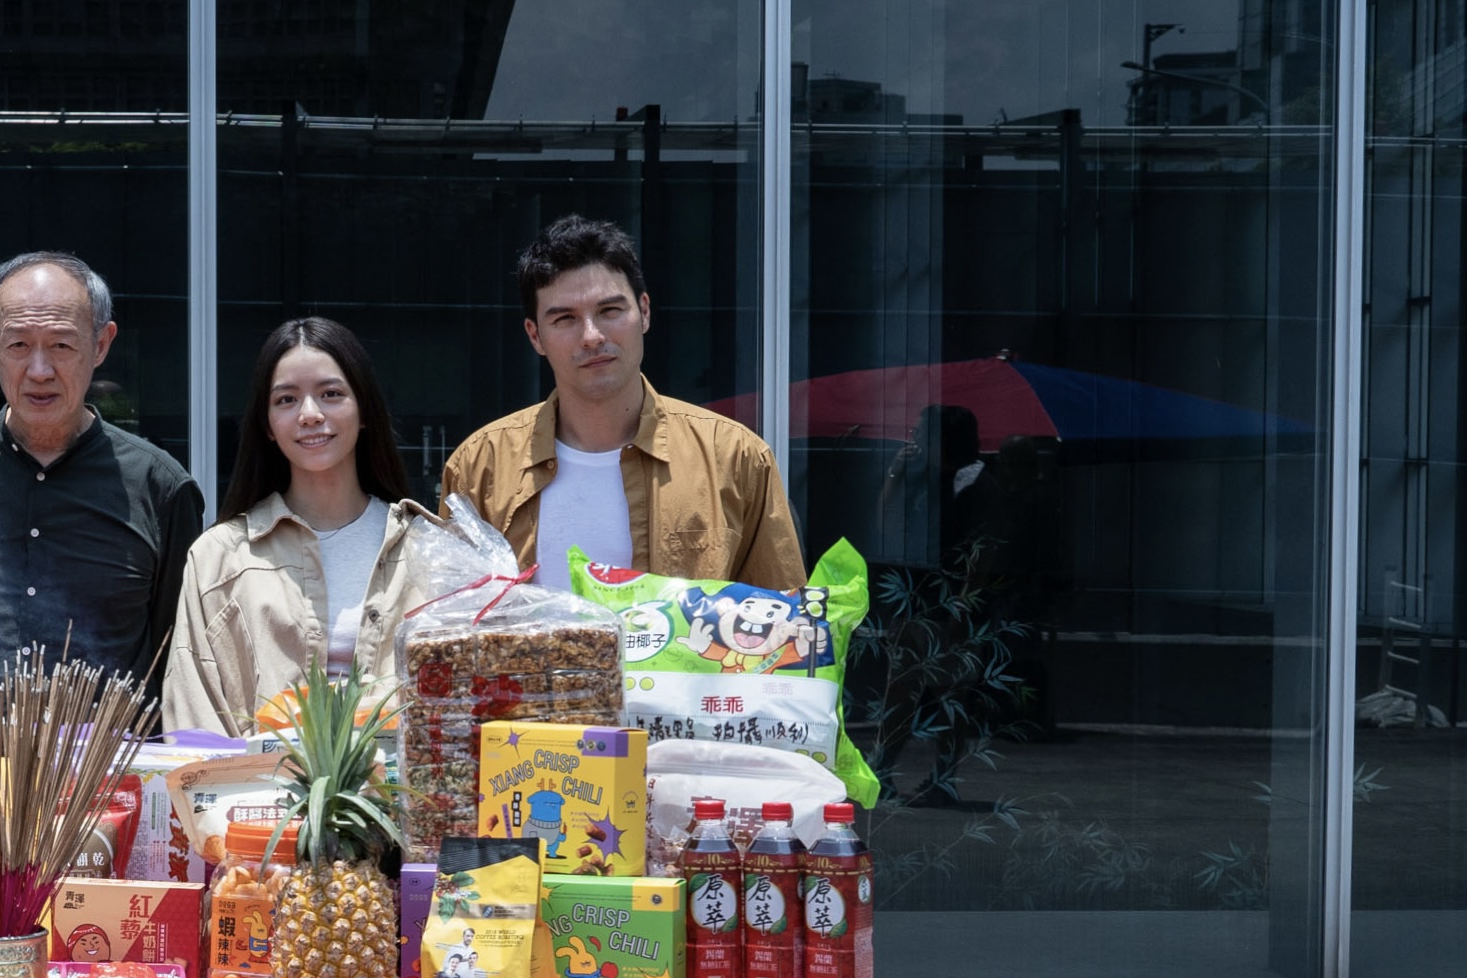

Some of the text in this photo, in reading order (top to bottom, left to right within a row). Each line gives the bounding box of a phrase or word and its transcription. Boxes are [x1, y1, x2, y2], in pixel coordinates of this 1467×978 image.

[700, 695, 744, 714] 乖乖
[488, 759, 535, 797] XIANG
[534, 749, 580, 774] CRISP
[561, 775, 603, 806] CHILI
[572, 902, 630, 929] CRISP
[697, 873, 727, 934] 原萃
[748, 875, 774, 936] 原萃
[807, 877, 833, 938] 原萃
[141, 920, 157, 963] 牛奶餅
[608, 930, 661, 961] CHILI
